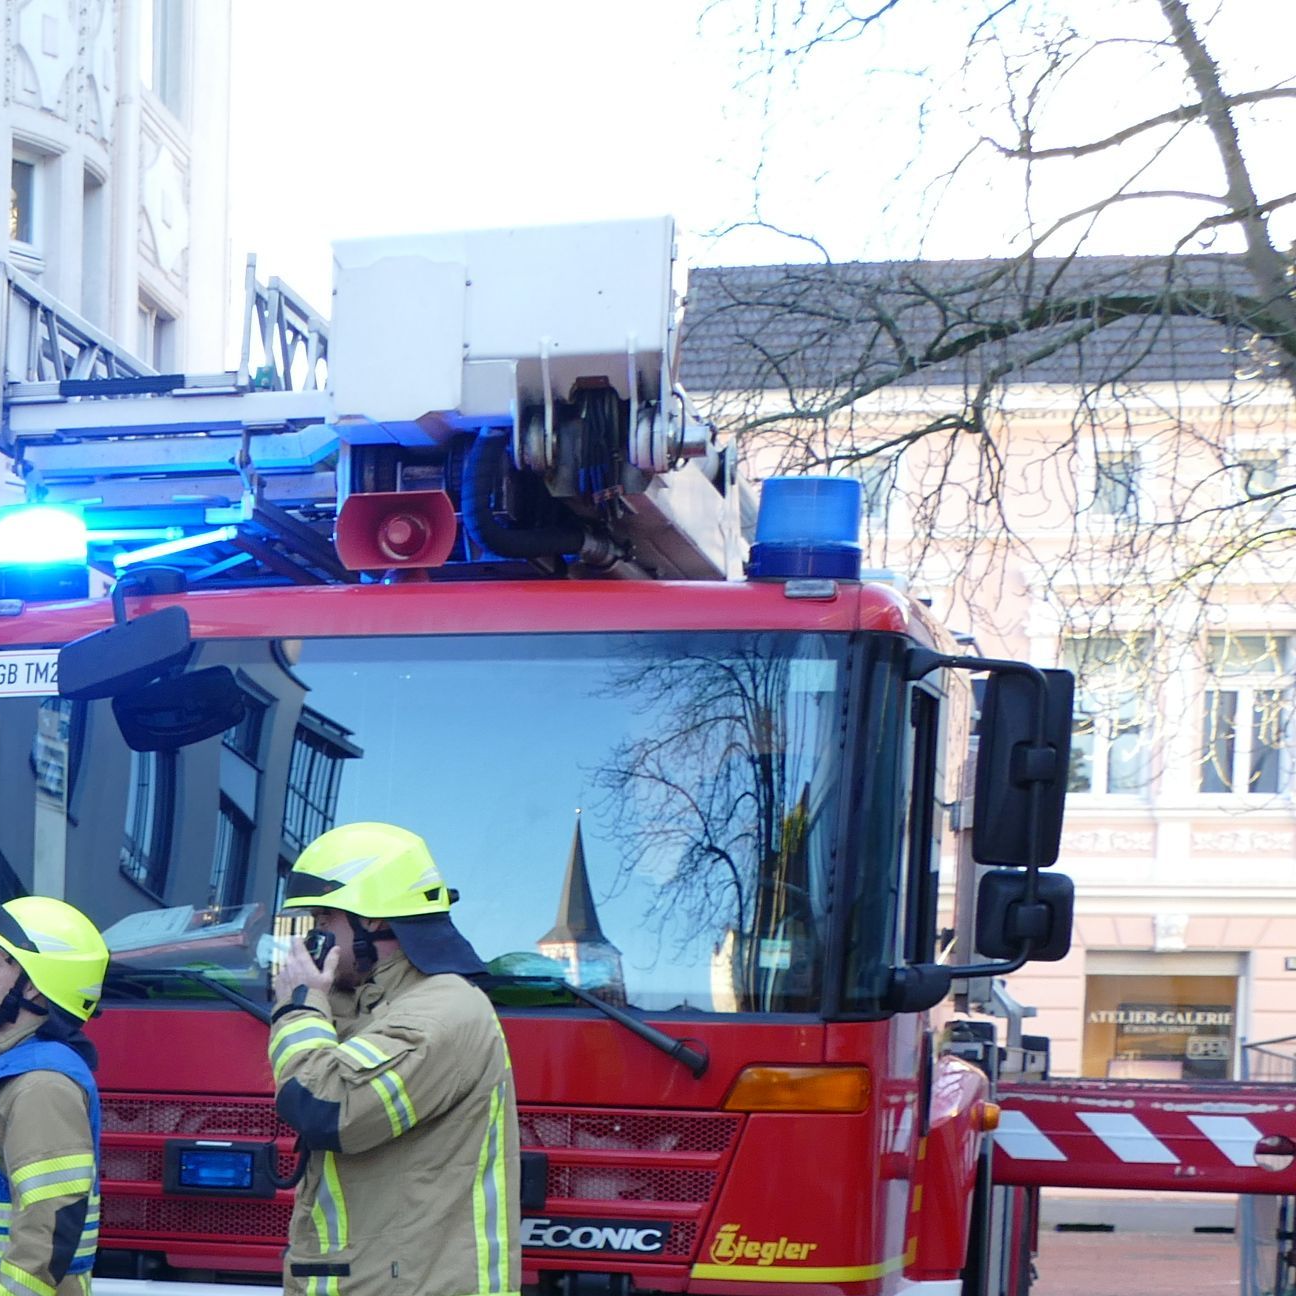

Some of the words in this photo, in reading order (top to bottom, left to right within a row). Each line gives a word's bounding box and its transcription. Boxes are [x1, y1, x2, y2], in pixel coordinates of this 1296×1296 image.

[25, 662, 58, 684] TM2
[1089, 1010, 1233, 1024] ATELIER-GALERIE
[521, 1218, 662, 1252] ECONIC
[710, 1224, 817, 1266] Ziegler
